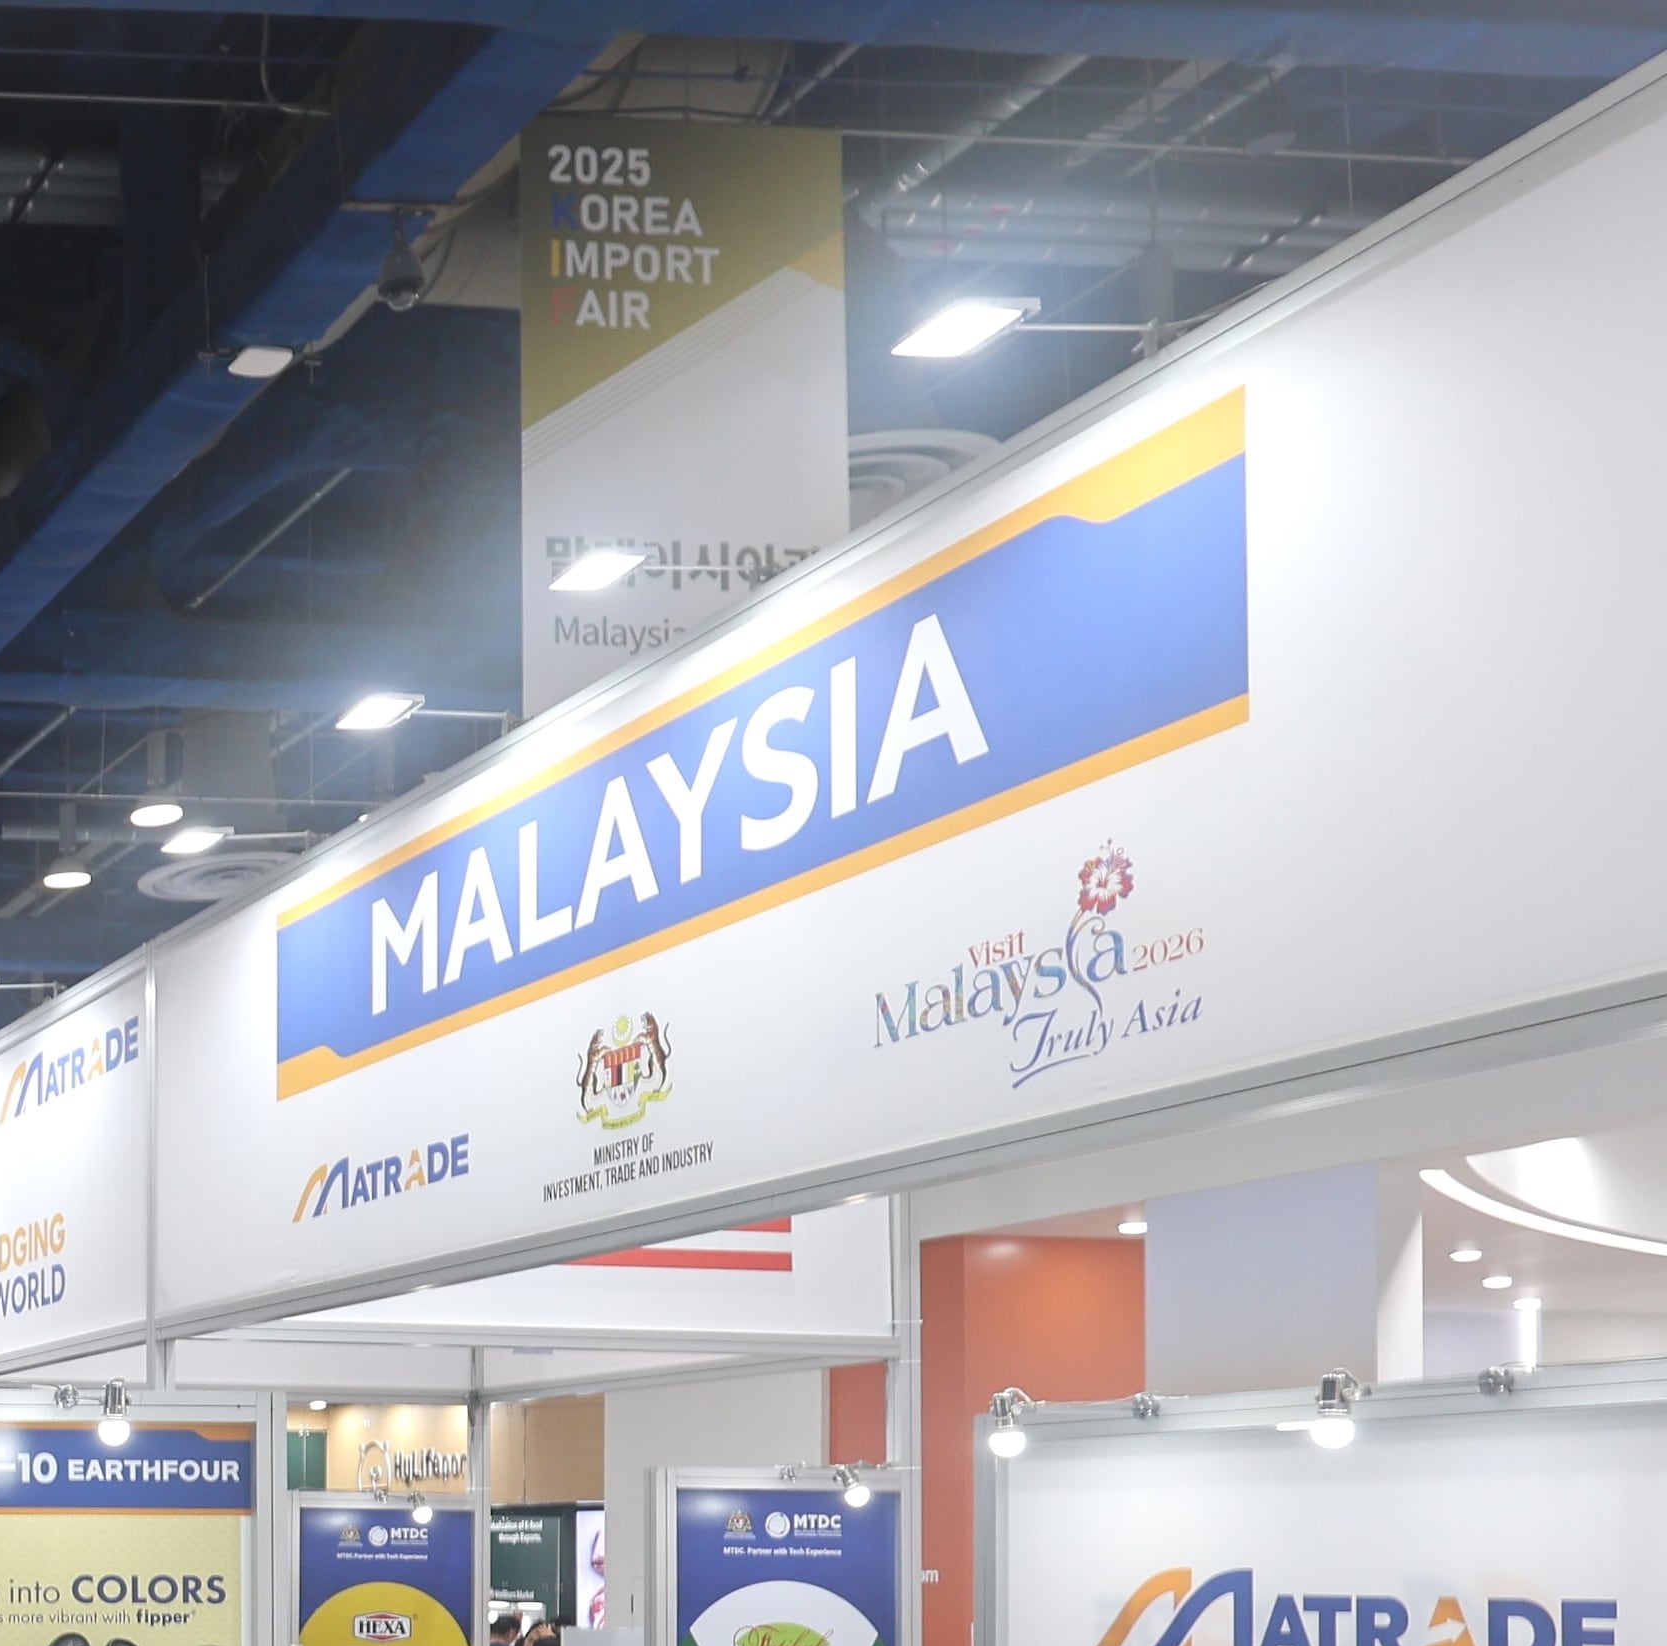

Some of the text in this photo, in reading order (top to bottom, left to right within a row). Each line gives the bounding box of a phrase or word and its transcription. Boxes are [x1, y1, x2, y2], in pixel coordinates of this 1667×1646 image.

[547, 145, 651, 187] 2025
[551, 240, 720, 284] IMPORT
[370, 614, 989, 1013] MALAYSIA
[967, 929, 1026, 969] Visit
[873, 916, 1205, 1048] Malaysia 2026
[1011, 988, 1203, 1073] Truly Asia
[0, 1015, 139, 1125] MATRADE
[593, 1132, 655, 1166] MINISTRY OF
[292, 1133, 469, 1223] MATRADE
[543, 1140, 714, 1202] INVESTMENT, TRADE AND INDUSTRY
[67, 1459, 241, 1484] EARTHFOUR
[390, 1528, 428, 1540] MTDC
[793, 1514, 842, 1529] MTDC
[747, 1547, 772, 1556] Partner
[773, 1547, 787, 1555] with
[805, 1547, 842, 1557] Experience
[9, 1578, 61, 1604] into
[71, 1574, 227, 1606] COLORS
[8, 1612, 44, 1625] more
[48, 1609, 98, 1625] vibrant
[101, 1609, 131, 1625] with
[136, 1609, 191, 1627] fipper
[358, 1617, 406, 1635] HEXA
